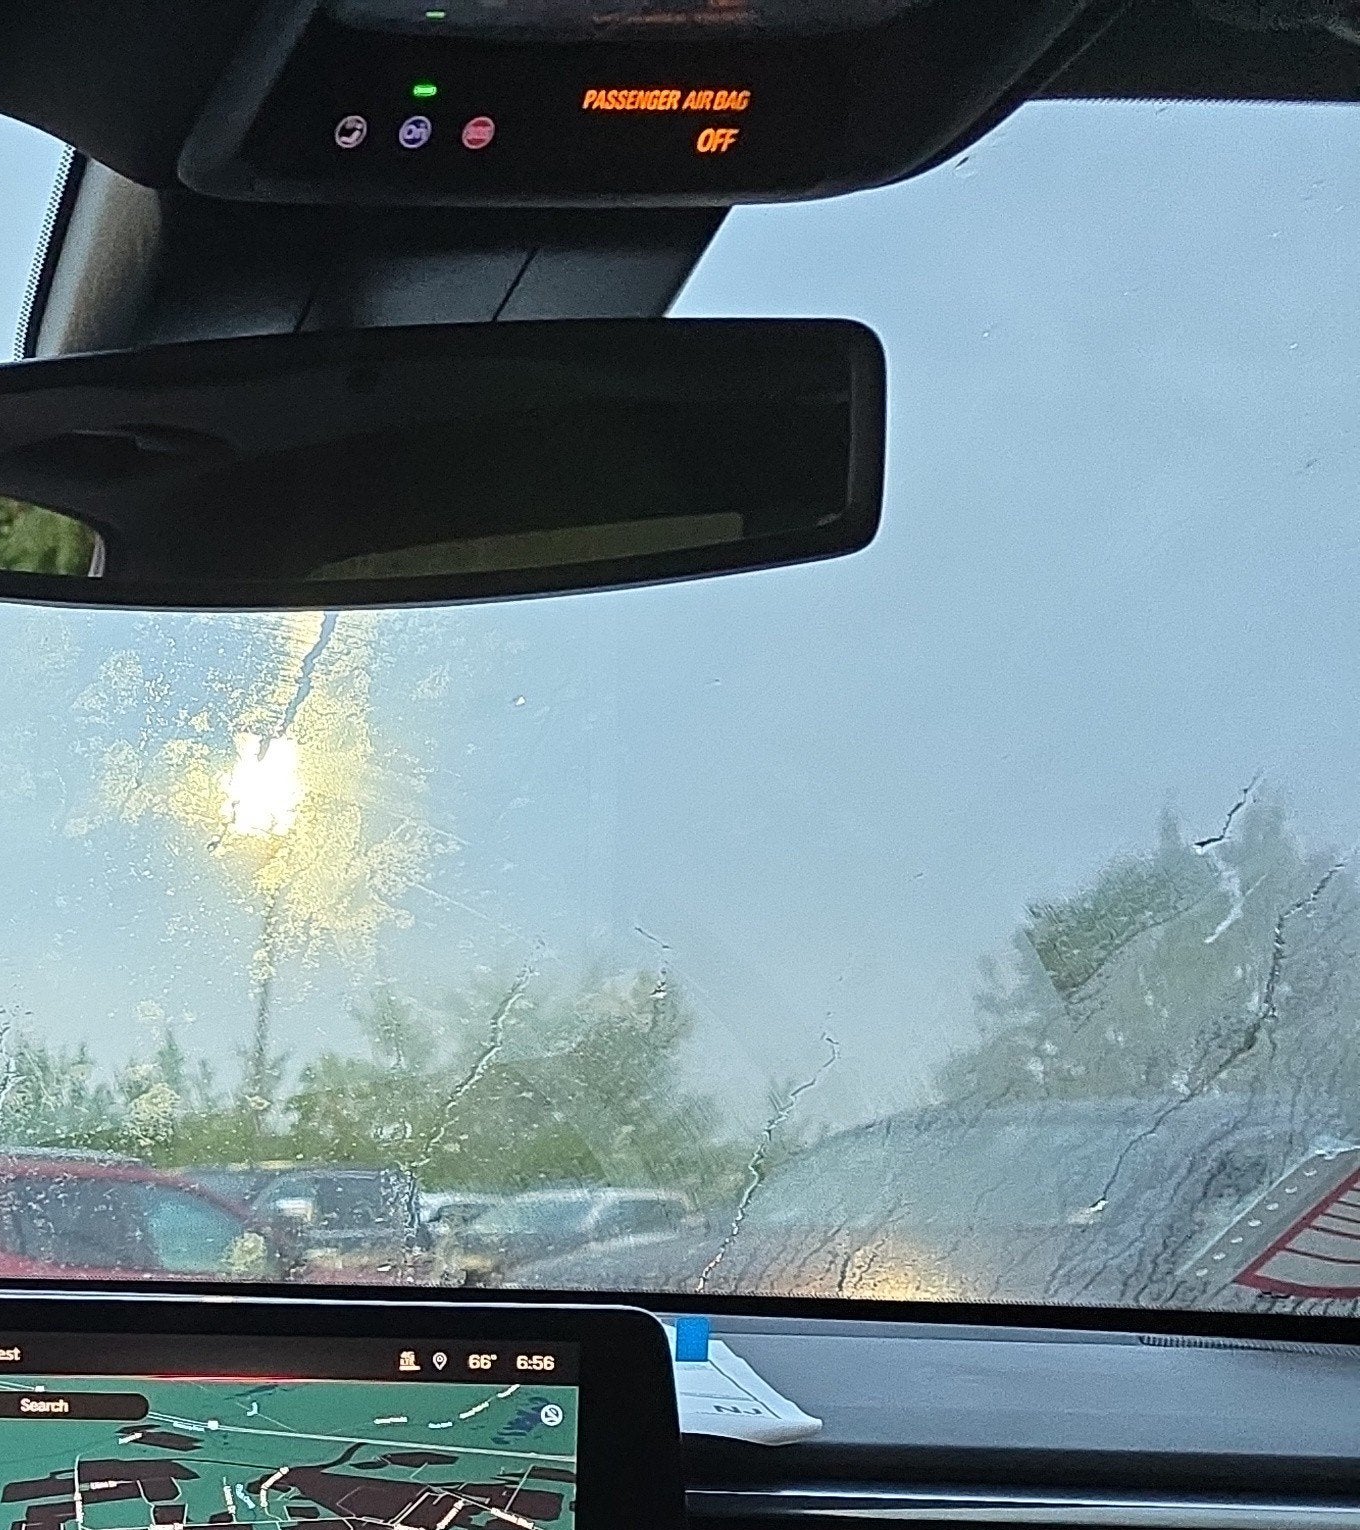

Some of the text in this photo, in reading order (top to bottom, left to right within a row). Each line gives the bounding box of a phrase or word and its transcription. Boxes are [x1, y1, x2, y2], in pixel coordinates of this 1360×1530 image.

[582, 89, 681, 110] PASSENGER
[696, 127, 740, 153] OFF
[467, 1353, 498, 1370] 66°
[515, 1355, 555, 1371] 6:56
[19, 1397, 70, 1413] Search
